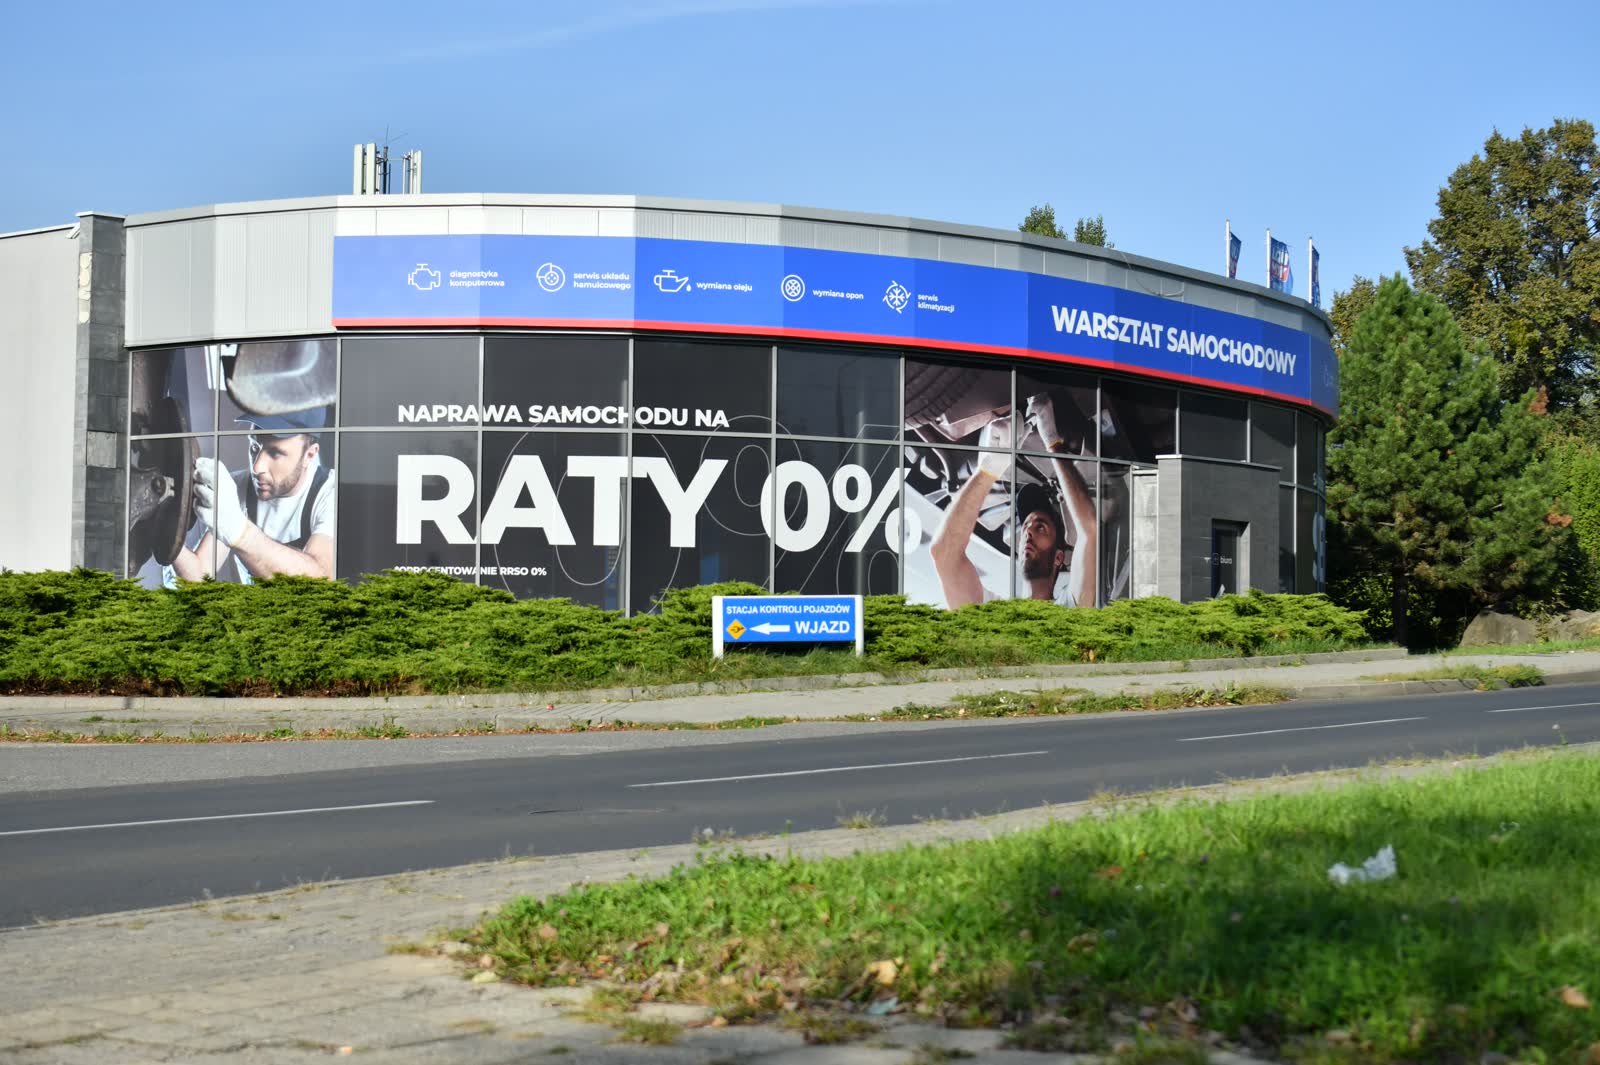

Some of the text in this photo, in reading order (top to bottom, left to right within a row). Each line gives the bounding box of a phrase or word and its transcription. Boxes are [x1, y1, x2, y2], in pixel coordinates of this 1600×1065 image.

[449, 270, 498, 279] diagnostyka
[573, 271, 600, 280] serwis
[449, 279, 505, 288] komputerowa
[573, 280, 631, 291] hamulcowego
[696, 281, 753, 292] wymiana oleju
[812, 288, 864, 300] wymiana opon
[917, 293, 939, 302] serwis
[917, 301, 955, 313] klimatyzacji
[1051, 304, 1163, 350] WARSZTAT
[1166, 326, 1297, 377] SAMOCHODOWY
[398, 404, 729, 428] NAPRAWA SAMOCHODU NA
[396, 454, 922, 555] RATY 0%
[499, 566, 529, 576] RRSO
[530, 566, 547, 577] 0%
[726, 603, 850, 614] STACJA KONTROLI POJAZDÓW
[795, 620, 850, 634] WJAZD
